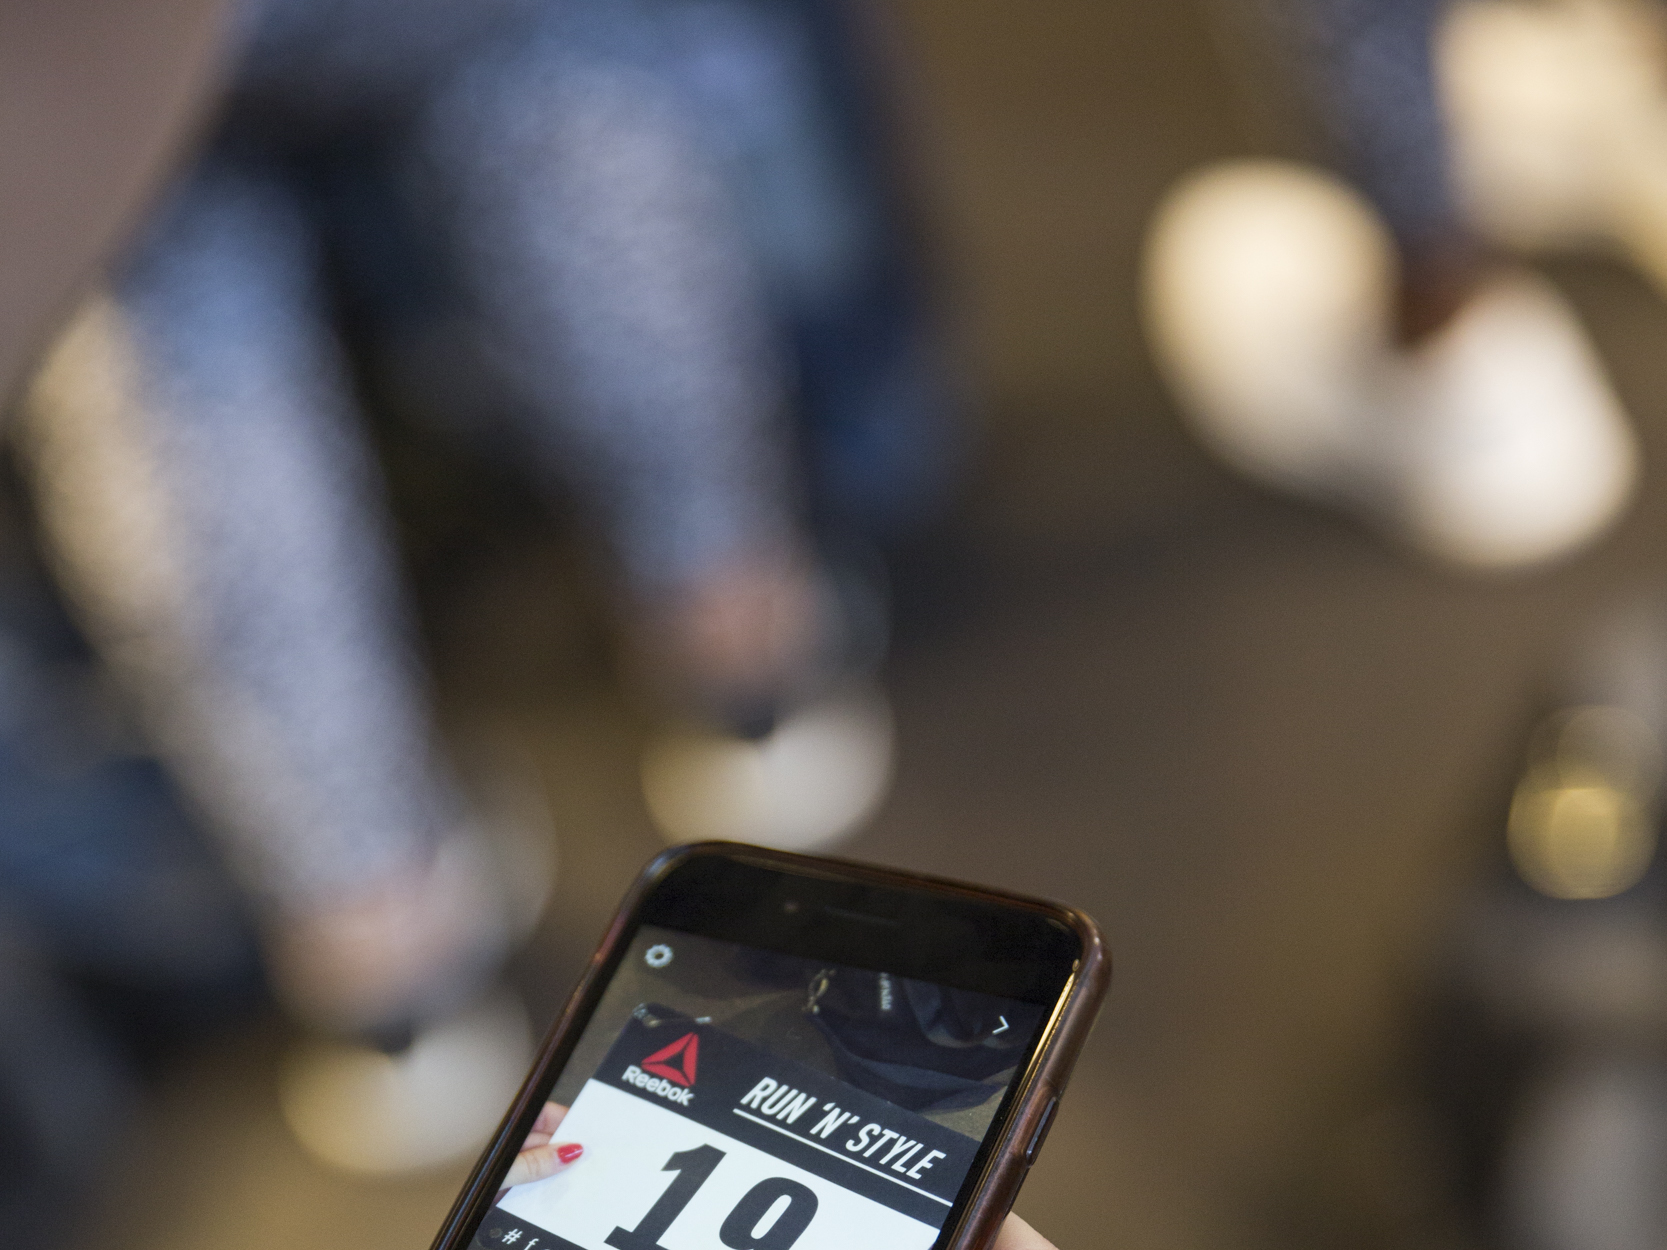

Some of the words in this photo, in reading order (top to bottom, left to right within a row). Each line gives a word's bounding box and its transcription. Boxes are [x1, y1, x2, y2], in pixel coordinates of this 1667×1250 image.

[622, 1065, 694, 1106] Reebok
[740, 1077, 817, 1124] RUN
[845, 1123, 946, 1180] STYLE
